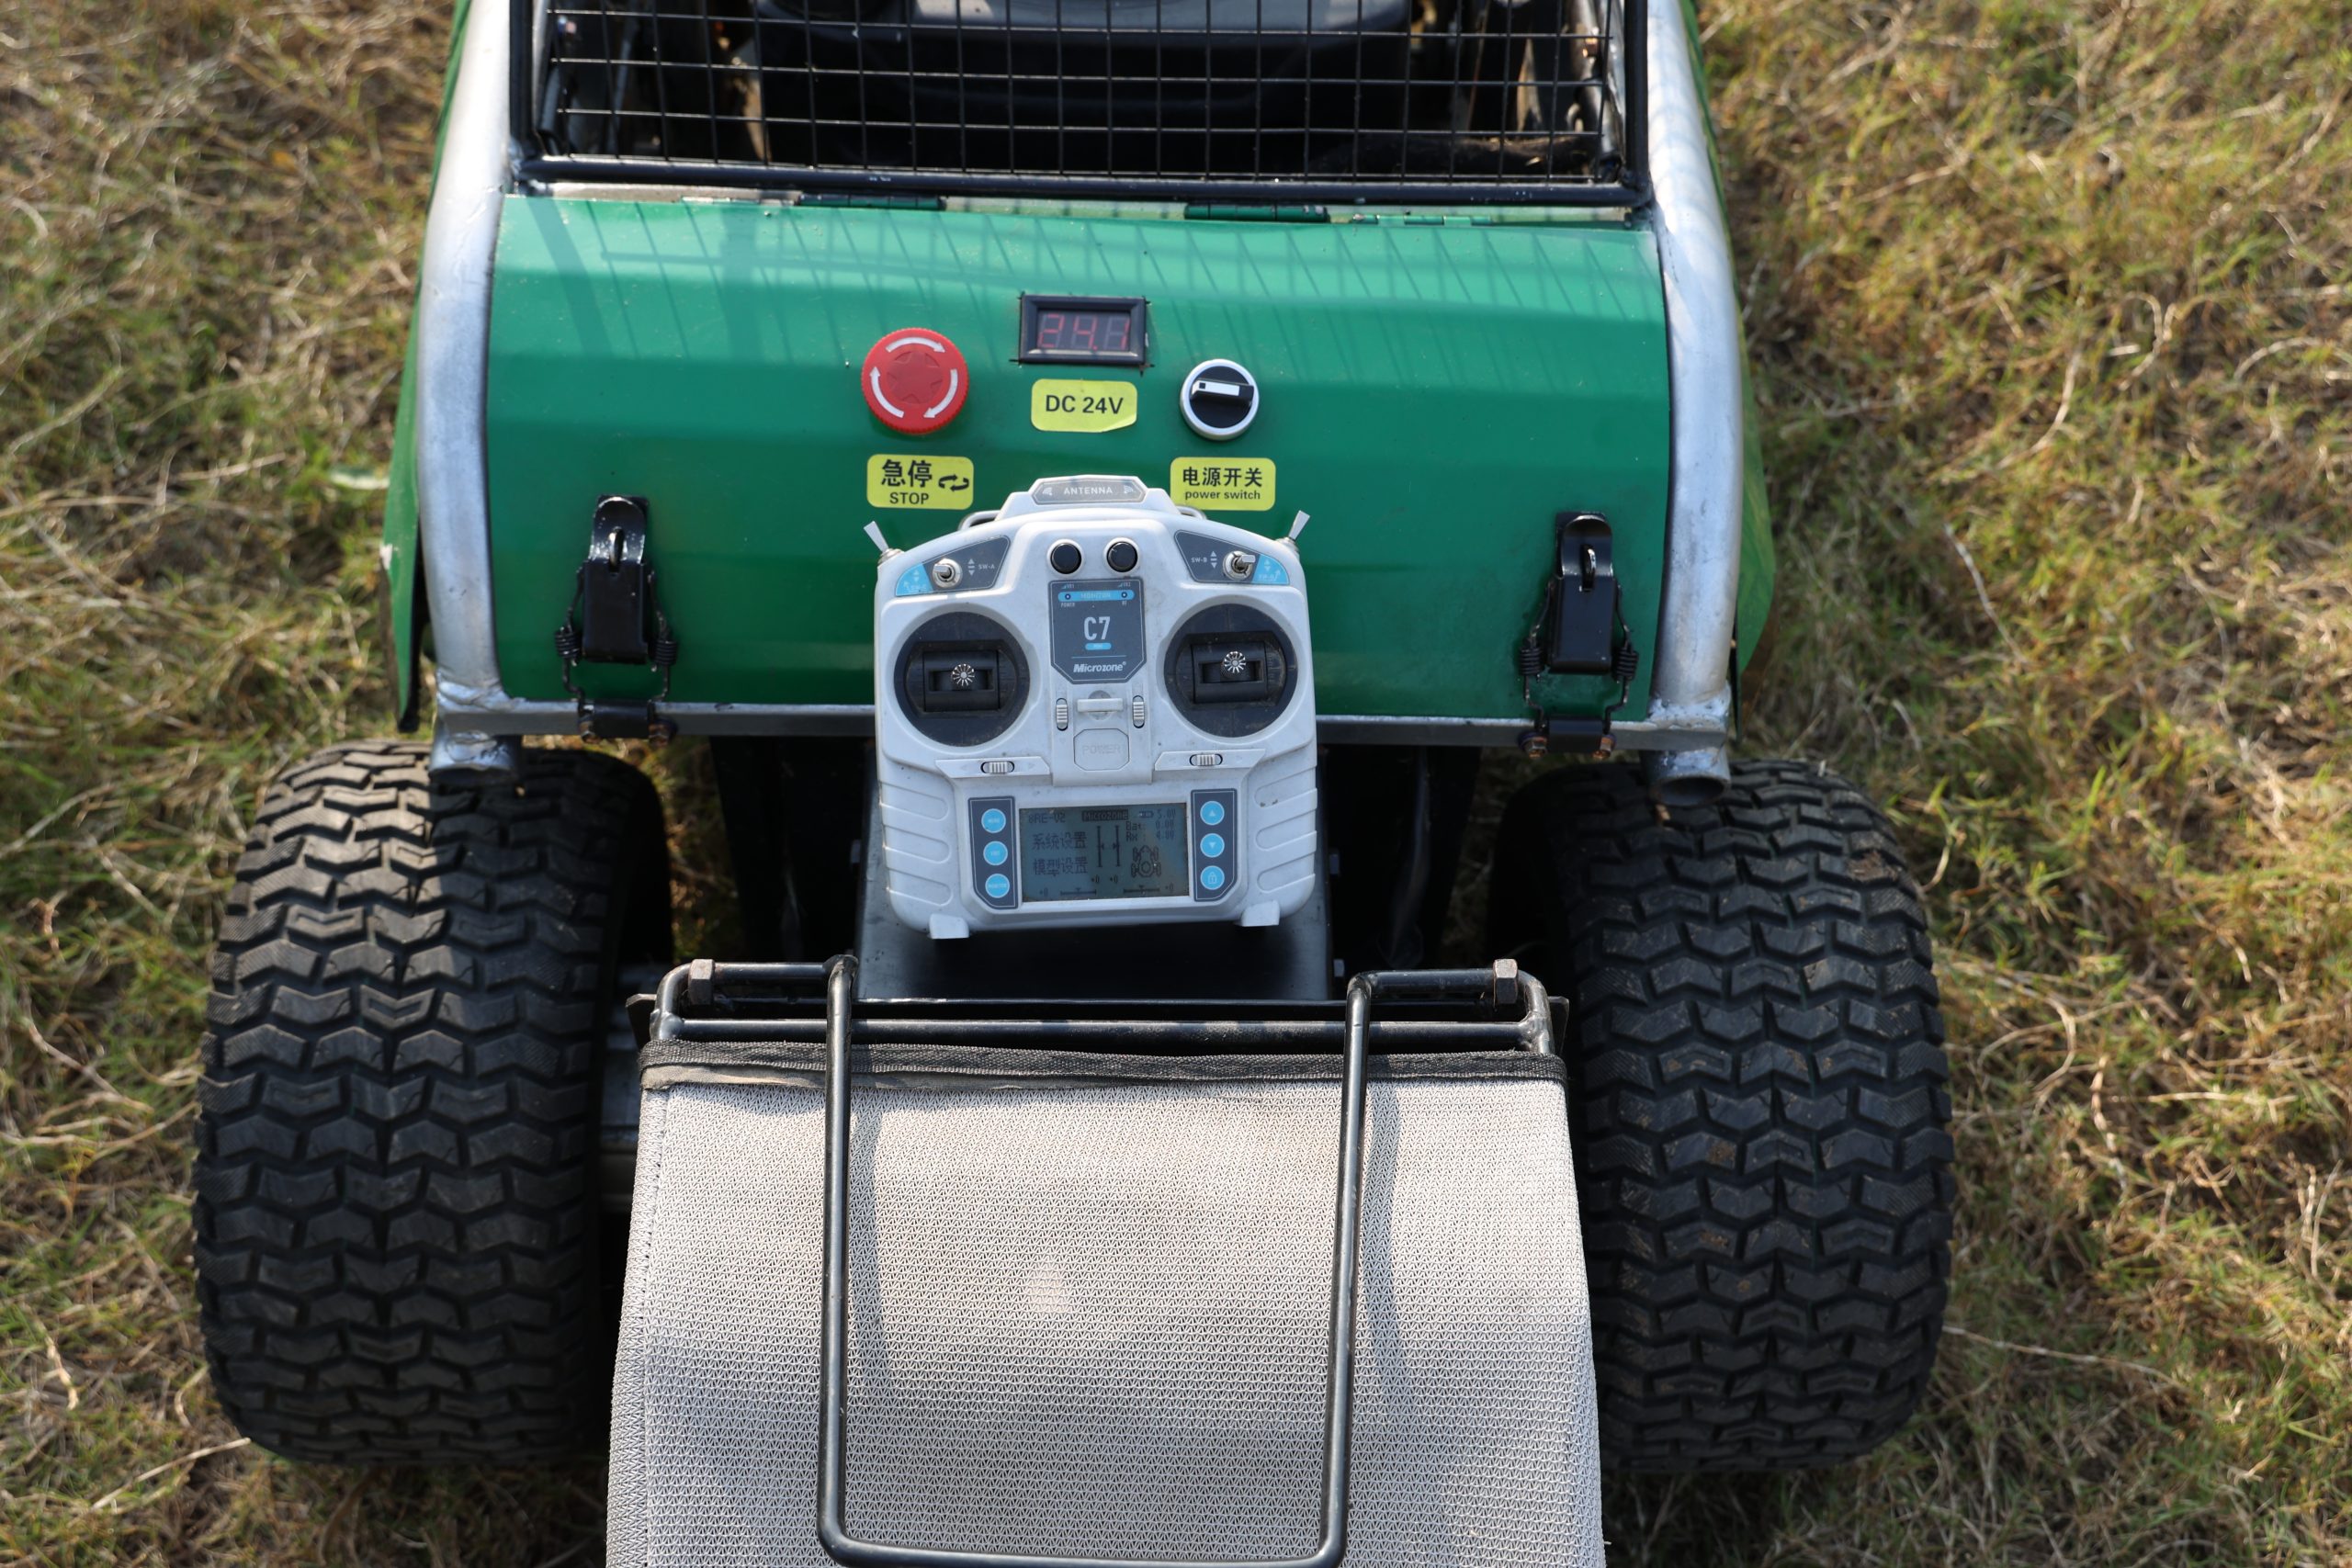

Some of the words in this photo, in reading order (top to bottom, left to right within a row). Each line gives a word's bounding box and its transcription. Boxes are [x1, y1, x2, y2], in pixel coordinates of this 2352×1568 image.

[1038, 313, 1130, 350] 24.1
[1046, 394, 1075, 412] DC
[1082, 396, 1124, 414] 24V
[881, 458, 933, 488] 急停
[1182, 467, 1263, 488] 电源开关
[889, 491, 930, 505] STOP
[1063, 486, 1114, 495] ANTENNA
[1184, 490, 1221, 501] power
[1223, 489, 1261, 500] switch
[1083, 615, 1112, 641] C7
[1073, 662, 1124, 672] Microzone
[1082, 743, 1122, 756] POWER
[1031, 830, 1088, 852] 系统设置
[1033, 855, 1089, 876] 模型设置
